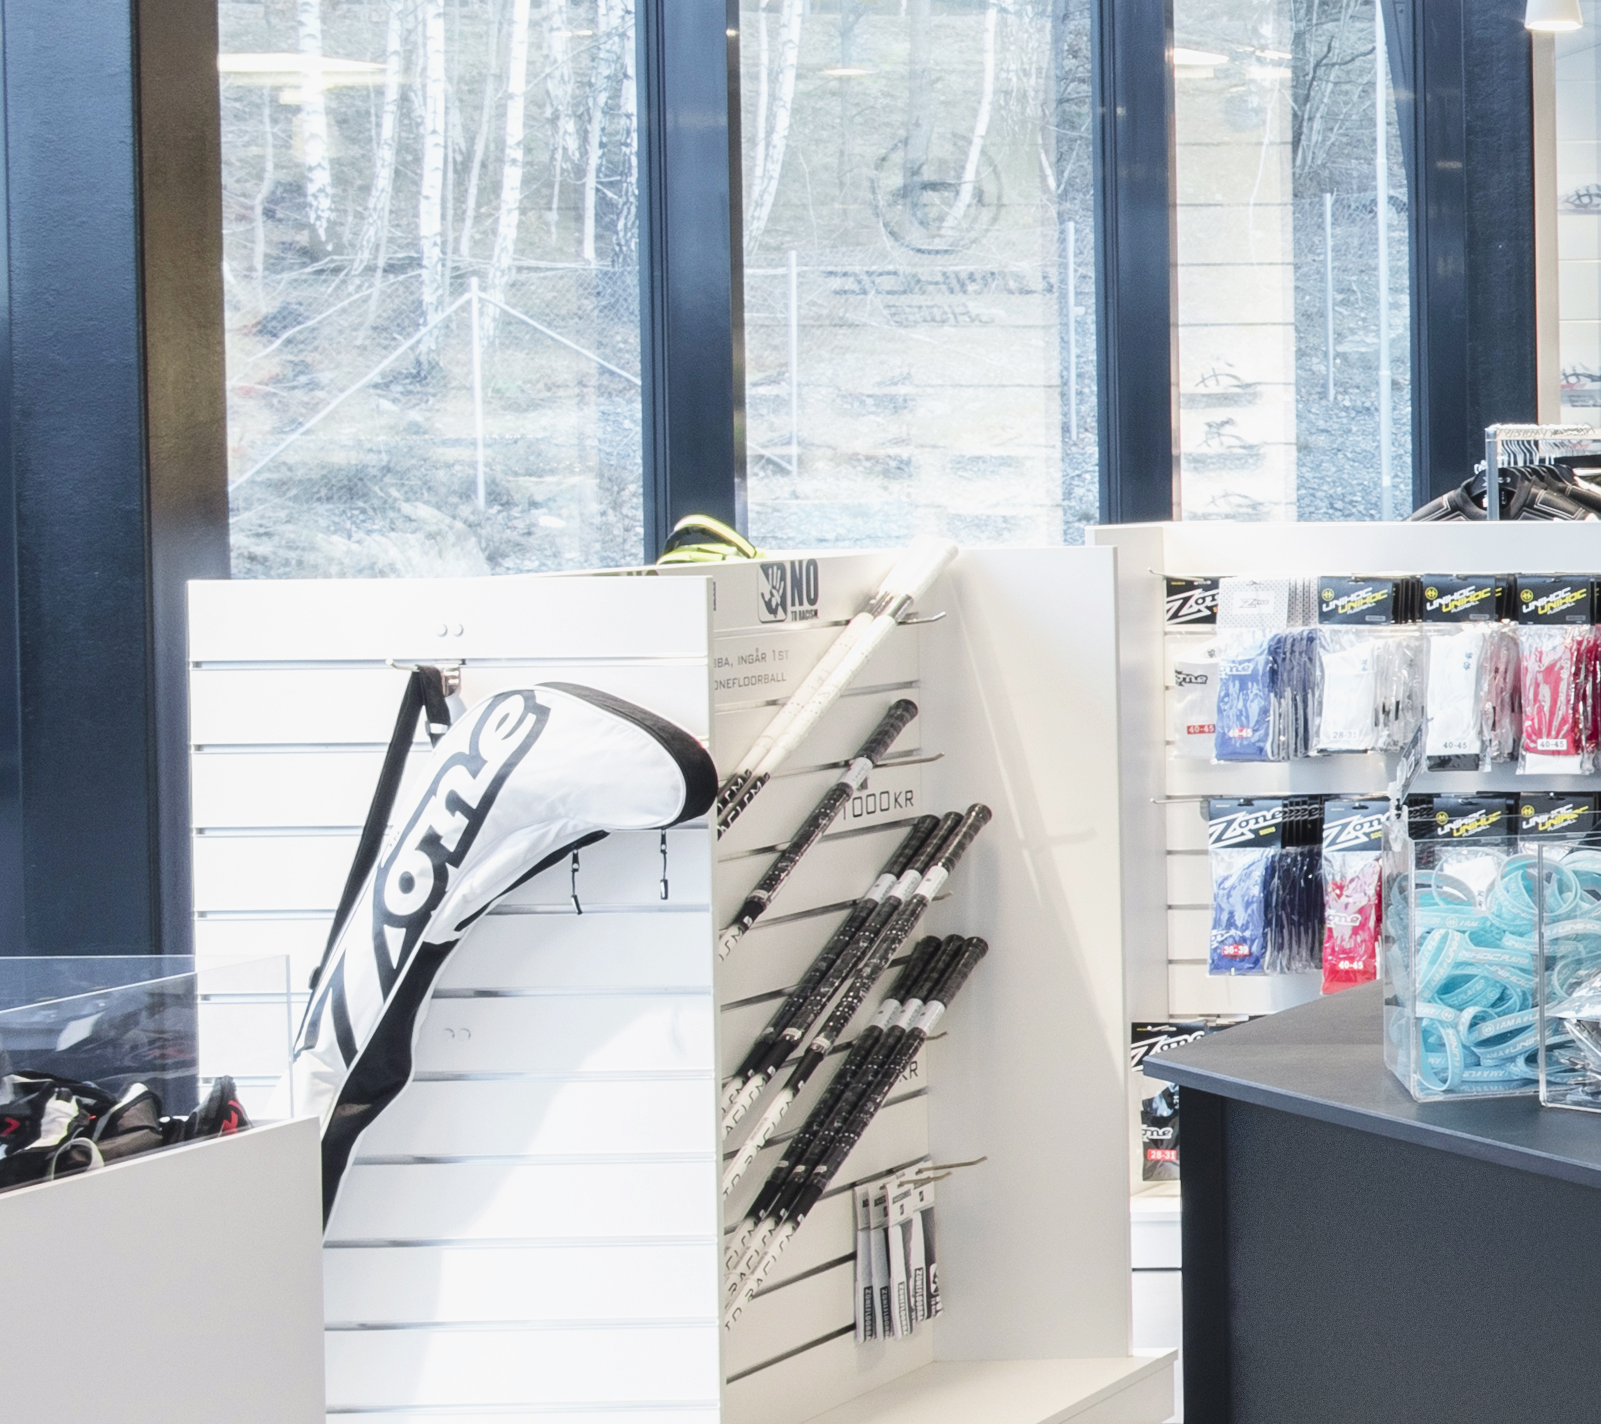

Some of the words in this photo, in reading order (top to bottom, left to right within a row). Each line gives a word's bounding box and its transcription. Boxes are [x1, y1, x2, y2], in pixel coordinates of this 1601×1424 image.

[790, 559, 819, 608] NO
[1322, 587, 1373, 612] UNIHOC
[1338, 589, 1389, 614] UNIHOC
[1426, 585, 1476, 611] UNIHOC
[1441, 587, 1491, 613] UNIHOC
[1522, 586, 1572, 613] UNIHOC
[1538, 588, 1587, 615] UNIHOC
[738, 648, 767, 665] INGÅR
[1187, 724, 1215, 734] 40-45
[1333, 731, 1357, 739] 28-31
[1443, 741, 1467, 749] 40-45
[1209, 807, 1283, 848] Zone
[1338, 959, 1363, 970] 40-45
[1150, 1149, 1176, 1160] 28-31
